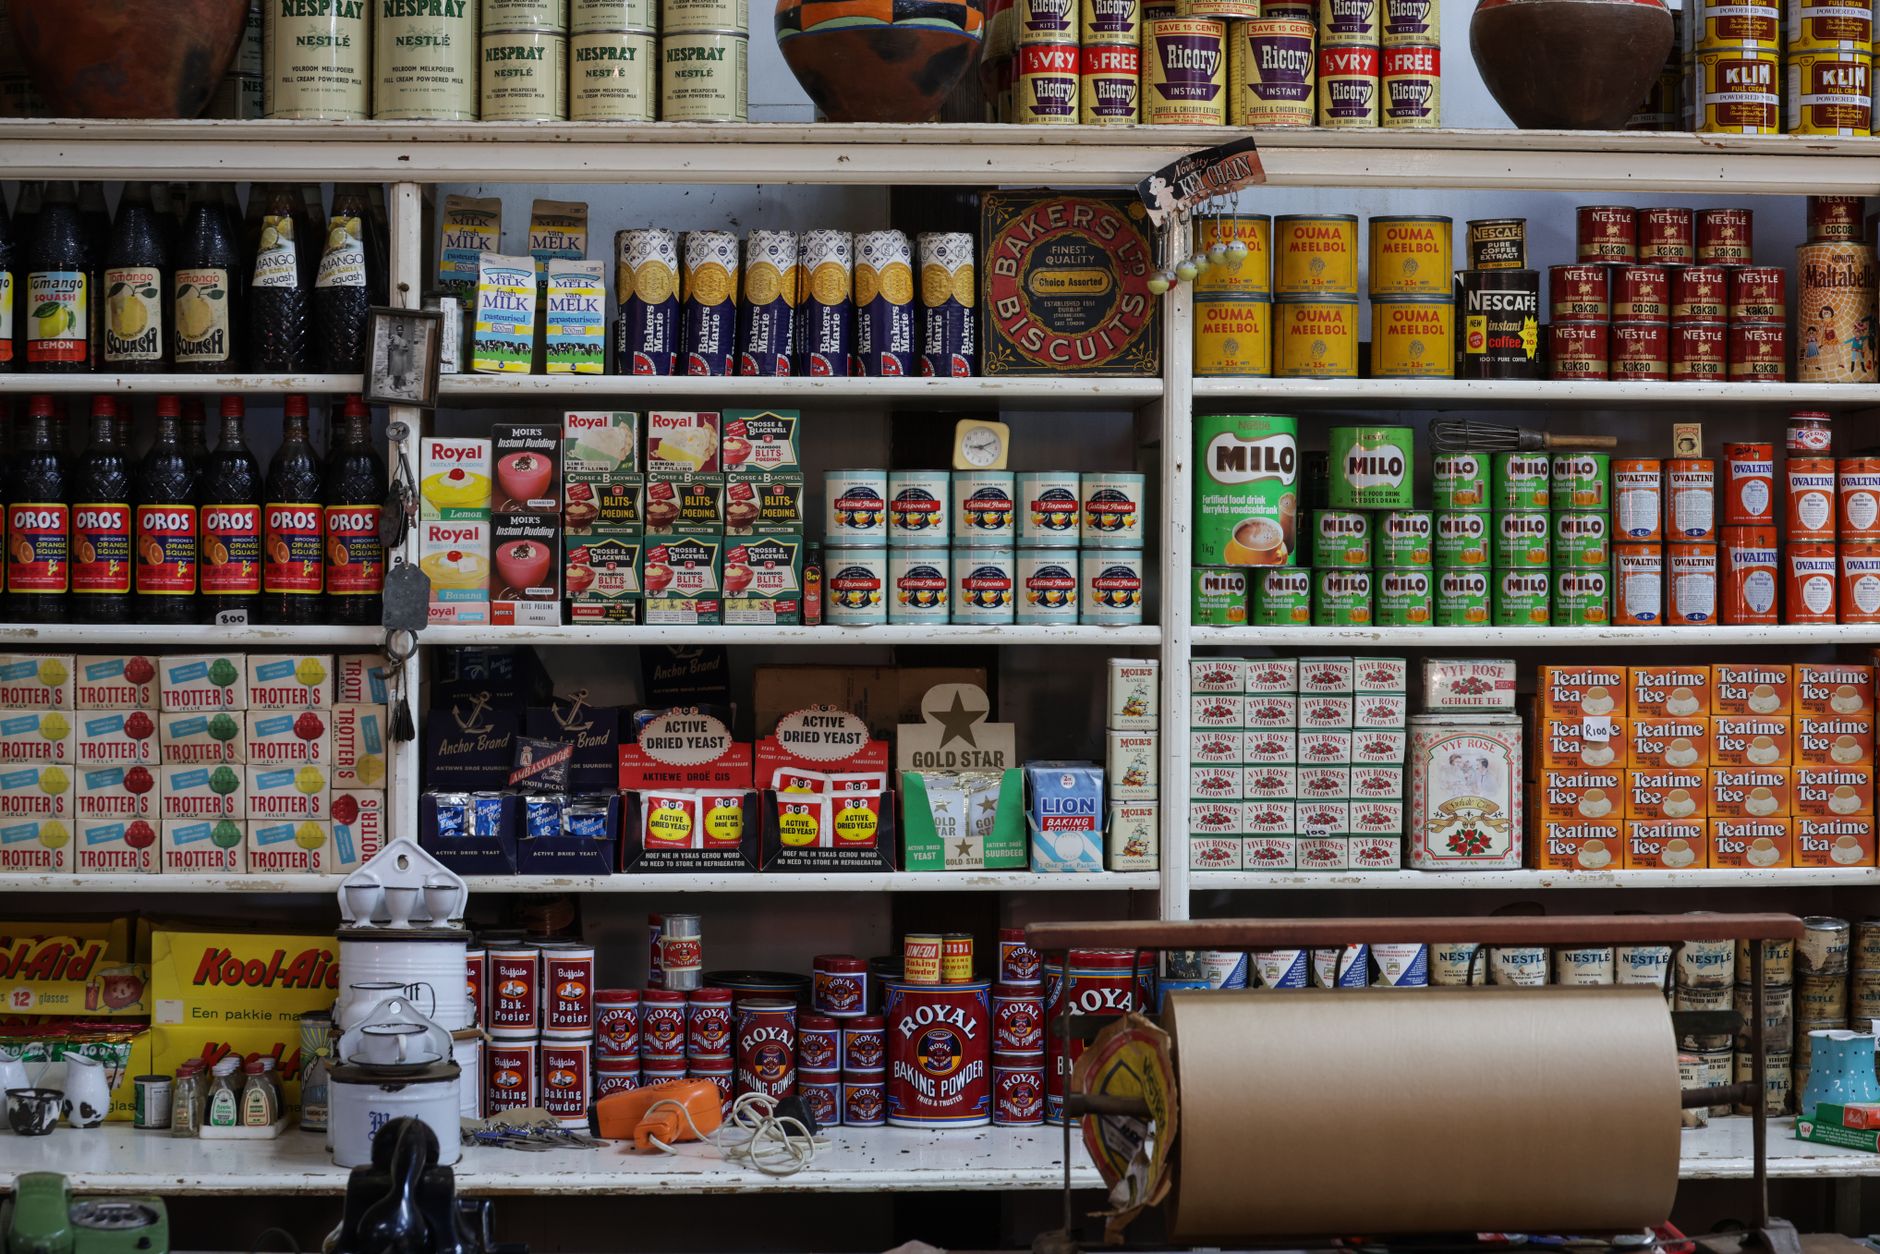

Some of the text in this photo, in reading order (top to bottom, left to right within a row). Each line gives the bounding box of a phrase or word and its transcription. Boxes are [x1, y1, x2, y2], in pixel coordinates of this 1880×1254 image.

[281, 0, 363, 19] NESPRAY
[1157, 23, 1181, 32] SAVE
[1195, 24, 1220, 33] CENTS
[296, 35, 350, 47] NESTLÉ
[485, 46, 545, 62] NESPRAY
[666, 47, 726, 62] NESPRAY
[1038, 51, 1075, 69] VRY
[1166, 45, 1217, 76] Ricory
[1262, 45, 1309, 76] Ricory
[1101, 52, 1137, 70] FREE
[674, 67, 713, 78] NESTLÉ
[1726, 64, 1771, 85] KLIM
[1036, 80, 1071, 103] Ricory
[1171, 87, 1206, 96] INSTANT
[1155, 106, 1172, 114] COFFEE
[1180, 106, 1202, 114] CHICORY
[1172, 158, 1209, 183] Novelty
[1178, 155, 1254, 200] KEY CHAIN
[1592, 212, 1632, 223] NESTLÉ
[1293, 227, 1342, 240] OUMA
[1473, 225, 1522, 239] NESCAFÉ
[994, 203, 1121, 279] BAKERS
[1289, 241, 1346, 253] MEELBOL
[1052, 246, 1087, 254] FINEST
[1598, 244, 1627, 256] kakao
[1045, 256, 1094, 265] QUALITY
[1480, 253, 1519, 261] EXTRACT
[29, 274, 84, 293] Tomango
[107, 271, 154, 284] Tomango
[331, 273, 364, 287] squash
[1039, 277, 1102, 287] Choice Assorted
[1625, 272, 1665, 282] NESTLÉ
[34, 293, 77, 302] SQUASH
[496, 288, 517, 298] fresh
[483, 295, 529, 311] MILK
[550, 298, 599, 312] MELK
[1468, 289, 1536, 311] NESCAFÉ
[1632, 302, 1659, 314] cocoa
[484, 313, 526, 323] pasteurised
[644, 305, 655, 353] Bakers
[654, 312, 664, 353] Marie
[996, 292, 1145, 363] BISCUITS
[1488, 320, 1522, 332] instant
[37, 340, 74, 350] LEMON
[106, 328, 158, 354] SQUASH
[1488, 335, 1521, 348] coffee
[568, 414, 608, 428] Royal
[512, 428, 542, 437] MOIR'S
[498, 438, 556, 450] Instant Pudding
[432, 443, 482, 459] Royal
[1216, 446, 1295, 472] MILO
[1349, 457, 1403, 476] MILO
[568, 474, 596, 483] CROSSE
[603, 473, 641, 483] BLACKWELL
[1792, 476, 1833, 486] OVALTINE
[603, 496, 633, 507] BLITS-
[1229, 496, 1266, 504] food drink
[450, 509, 482, 519] Lemon
[601, 509, 635, 519] POEDING
[1231, 505, 1278, 514] voedseldrank
[14, 511, 61, 529] OROS
[329, 513, 375, 531] OROS
[1560, 521, 1601, 533] MILO
[1205, 577, 1245, 591] MILO
[445, 591, 482, 600] Banana
[220, 614, 245, 625] 800
[1250, 663, 1292, 673] FIVE ROSES
[1440, 665, 1505, 678] VYF ROSE
[1551, 670, 1621, 686] Teatime
[1251, 681, 1291, 690] CEYLON TEA
[1550, 687, 1580, 702] Tea
[665, 720, 708, 733] ACTIVE
[1585, 724, 1607, 737] R100
[1800, 719, 1869, 735] Teatime
[438, 733, 511, 756] Anchor Brand
[647, 736, 725, 749] DRIED YEAST
[1800, 735, 1829, 750] Tee
[511, 748, 570, 783] AMBASSADOR
[912, 750, 1004, 768] GOLD STAR
[642, 773, 682, 781] AKTIEWE
[715, 773, 730, 781] GIS
[522, 780, 564, 791] TOOTH PICKS
[1041, 797, 1095, 813] LION
[1120, 809, 1153, 817] MOIR'S
[1046, 817, 1089, 826] BAKING
[906, 945, 937, 958] UNEDA
[1686, 951, 1733, 965] NESTLÉ
[500, 966, 527, 979] Buffalo
[13, 992, 69, 1006] 12 glasses
[501, 1000, 526, 1009] Bak-
[192, 1007, 272, 1022] Een pakkie
[495, 1010, 530, 1021] Poeier
[601, 1008, 637, 1027] ROYAL
[898, 1004, 977, 1039] ROYAL
[894, 1060, 984, 1098] BAKING POWDER
[545, 1088, 582, 1100] Baking
[917, 1094, 933, 1104] TRIED
[939, 1095, 963, 1107] TRUSTED
